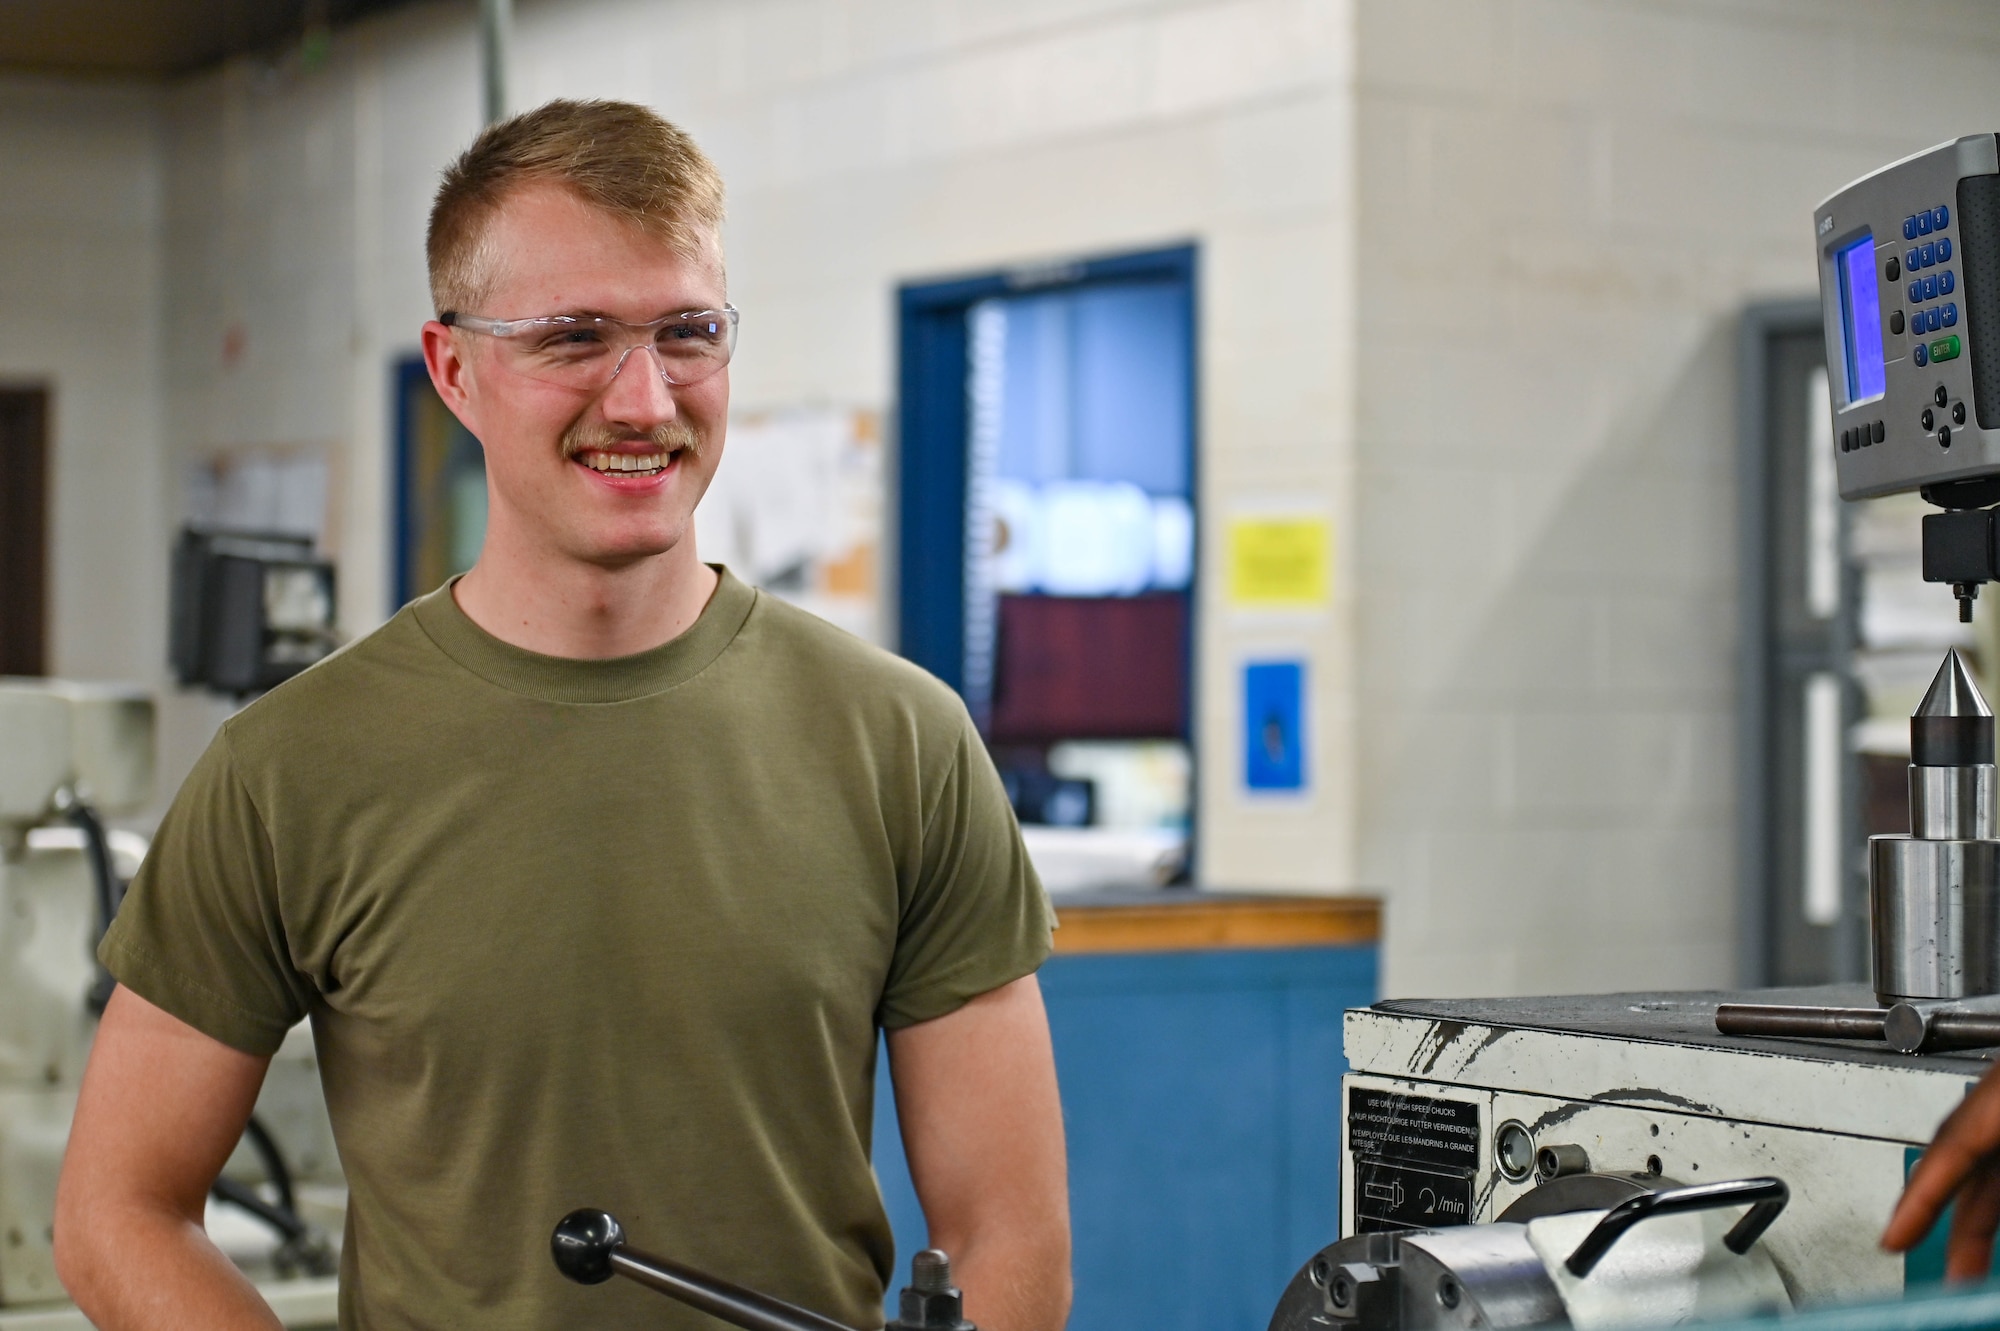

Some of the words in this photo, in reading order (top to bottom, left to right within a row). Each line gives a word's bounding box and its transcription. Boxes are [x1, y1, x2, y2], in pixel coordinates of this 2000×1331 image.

[1933, 343, 1950, 356] ENTER
[1367, 1099, 1379, 1107] USE
[1380, 1100, 1395, 1108] ONLY
[1395, 1102, 1410, 1111] HIGH
[1411, 1104, 1430, 1113] SPEED
[1431, 1106, 1456, 1117] CHUCKS
[1354, 1112, 1367, 1120] NUR
[1367, 1114, 1409, 1126] HOCHTOURIGE
[1410, 1119, 1432, 1130] FUTTER
[1432, 1122, 1470, 1134] VERWENDEN
[1352, 1139, 1375, 1149] VITESSE
[1388, 1133, 1400, 1142] QUE
[1449, 1142, 1474, 1153] GRANDE
[1437, 1196, 1464, 1214] /min
